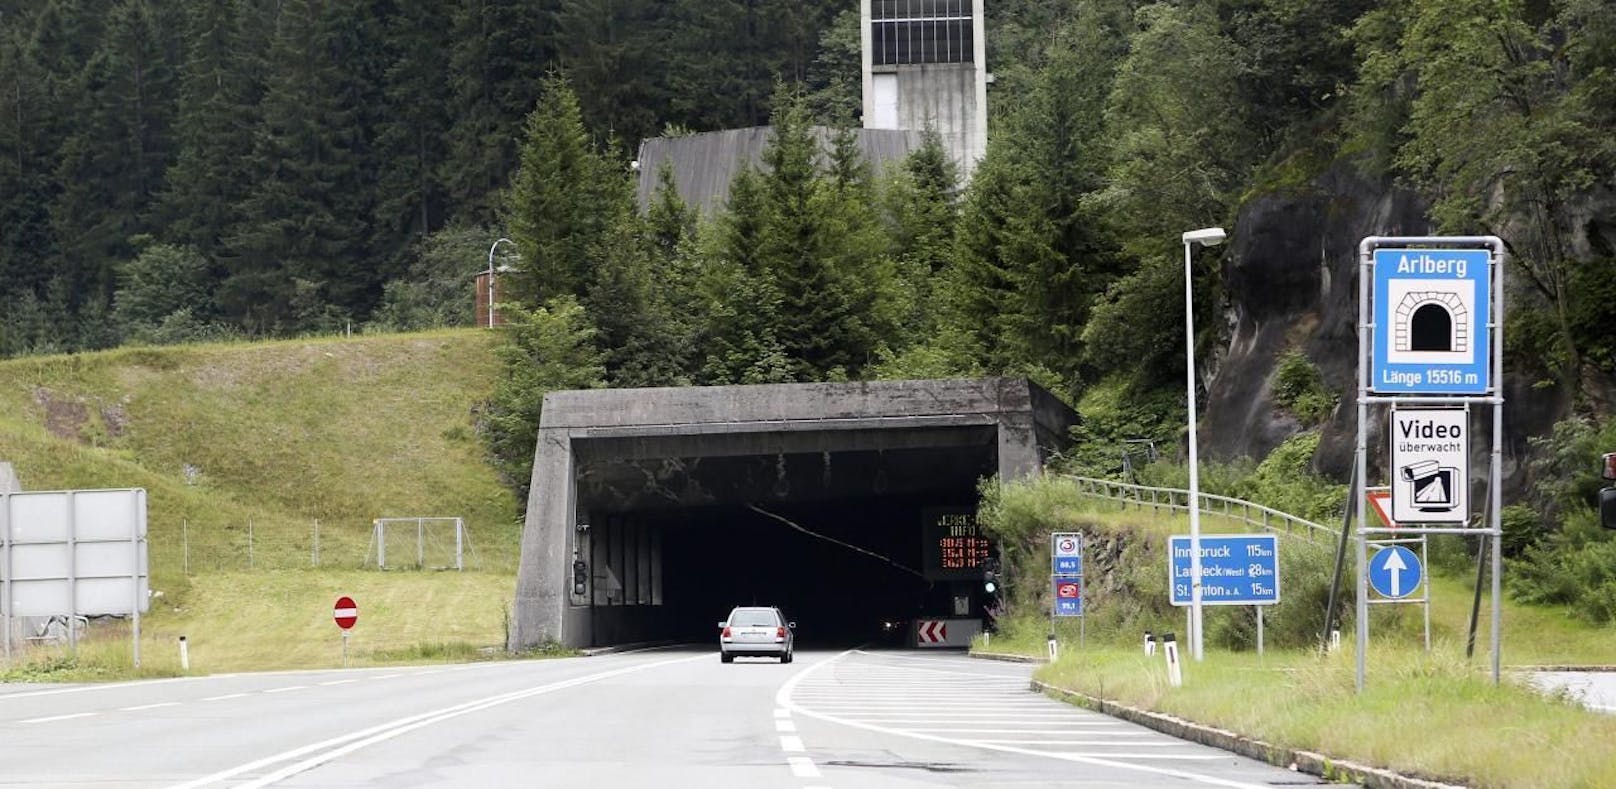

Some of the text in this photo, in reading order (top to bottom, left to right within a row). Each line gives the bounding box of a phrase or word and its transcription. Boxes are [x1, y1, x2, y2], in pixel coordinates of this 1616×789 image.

[1397, 255, 1467, 278] Arlberg
[1383, 370, 1478, 387] Länge 15516 m
[1400, 420, 1461, 439] Video
[1399, 442, 1461, 453] überwacht
[1174, 545, 1231, 558] Innbruck
[1197, 584, 1225, 597] nton
